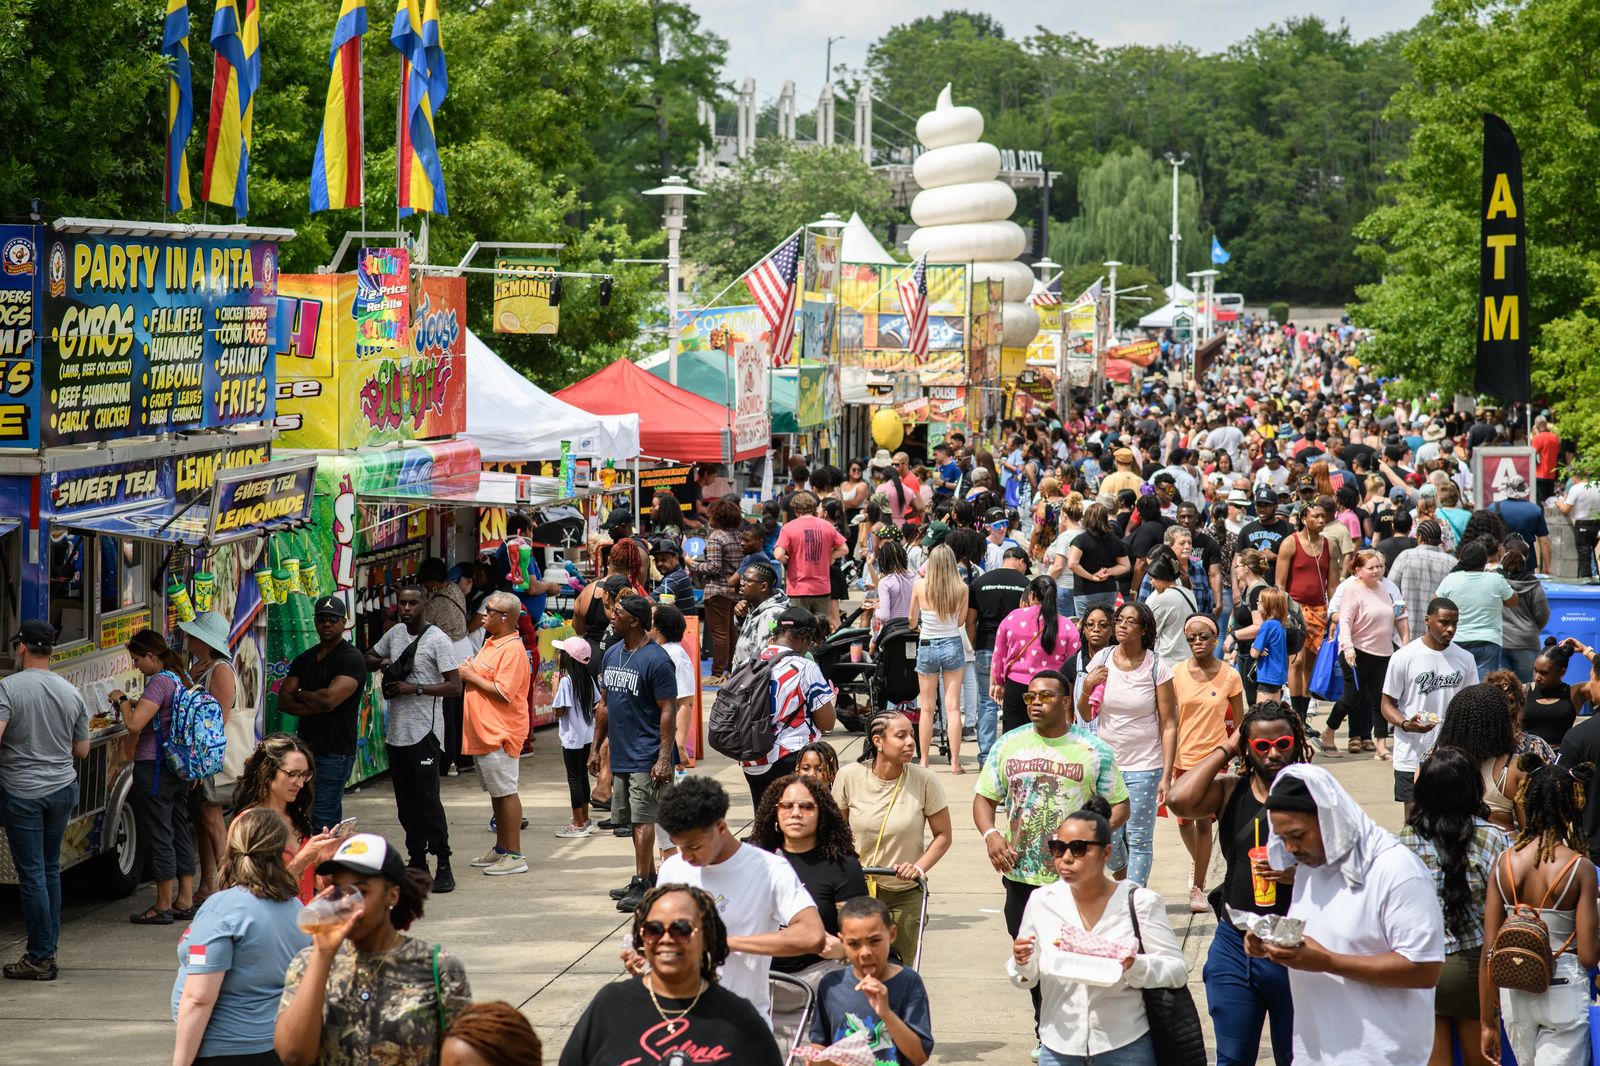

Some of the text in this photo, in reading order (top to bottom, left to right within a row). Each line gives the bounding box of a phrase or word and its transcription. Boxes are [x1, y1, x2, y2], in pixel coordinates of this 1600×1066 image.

[74, 243, 159, 290] PARTY
[166, 246, 187, 290] IN
[191, 247, 206, 292] A
[210, 247, 254, 292] PITA
[1484, 174, 1518, 341] ATM
[0, 290, 31, 304] DERS
[360, 284, 408, 301] 1/2 Price
[495, 279, 550, 299] LEMONA
[59, 303, 134, 360] GYROS
[150, 307, 203, 333] FALAFEL
[694, 311, 756, 331] COTTON
[221, 323, 268, 345] CORN DOGS
[150, 335, 204, 361] HUMMUS
[220, 346, 269, 376] SHRIMP
[150, 362, 204, 391] TABOULI
[58, 381, 132, 409] BEEF SHAWARMA
[150, 389, 203, 409] GRAPE LEAVES
[219, 378, 267, 418] FRIES
[929, 387, 958, 400] POLISH
[58, 405, 132, 435] GARLIC CHICKEN
[149, 409, 169, 425] BABA
[55, 470, 157, 508] SWEET TEA
[233, 473, 297, 502] SWEET TEA
[214, 493, 305, 531] LEMONADE
[1249, 531, 1282, 542] DETROIT
